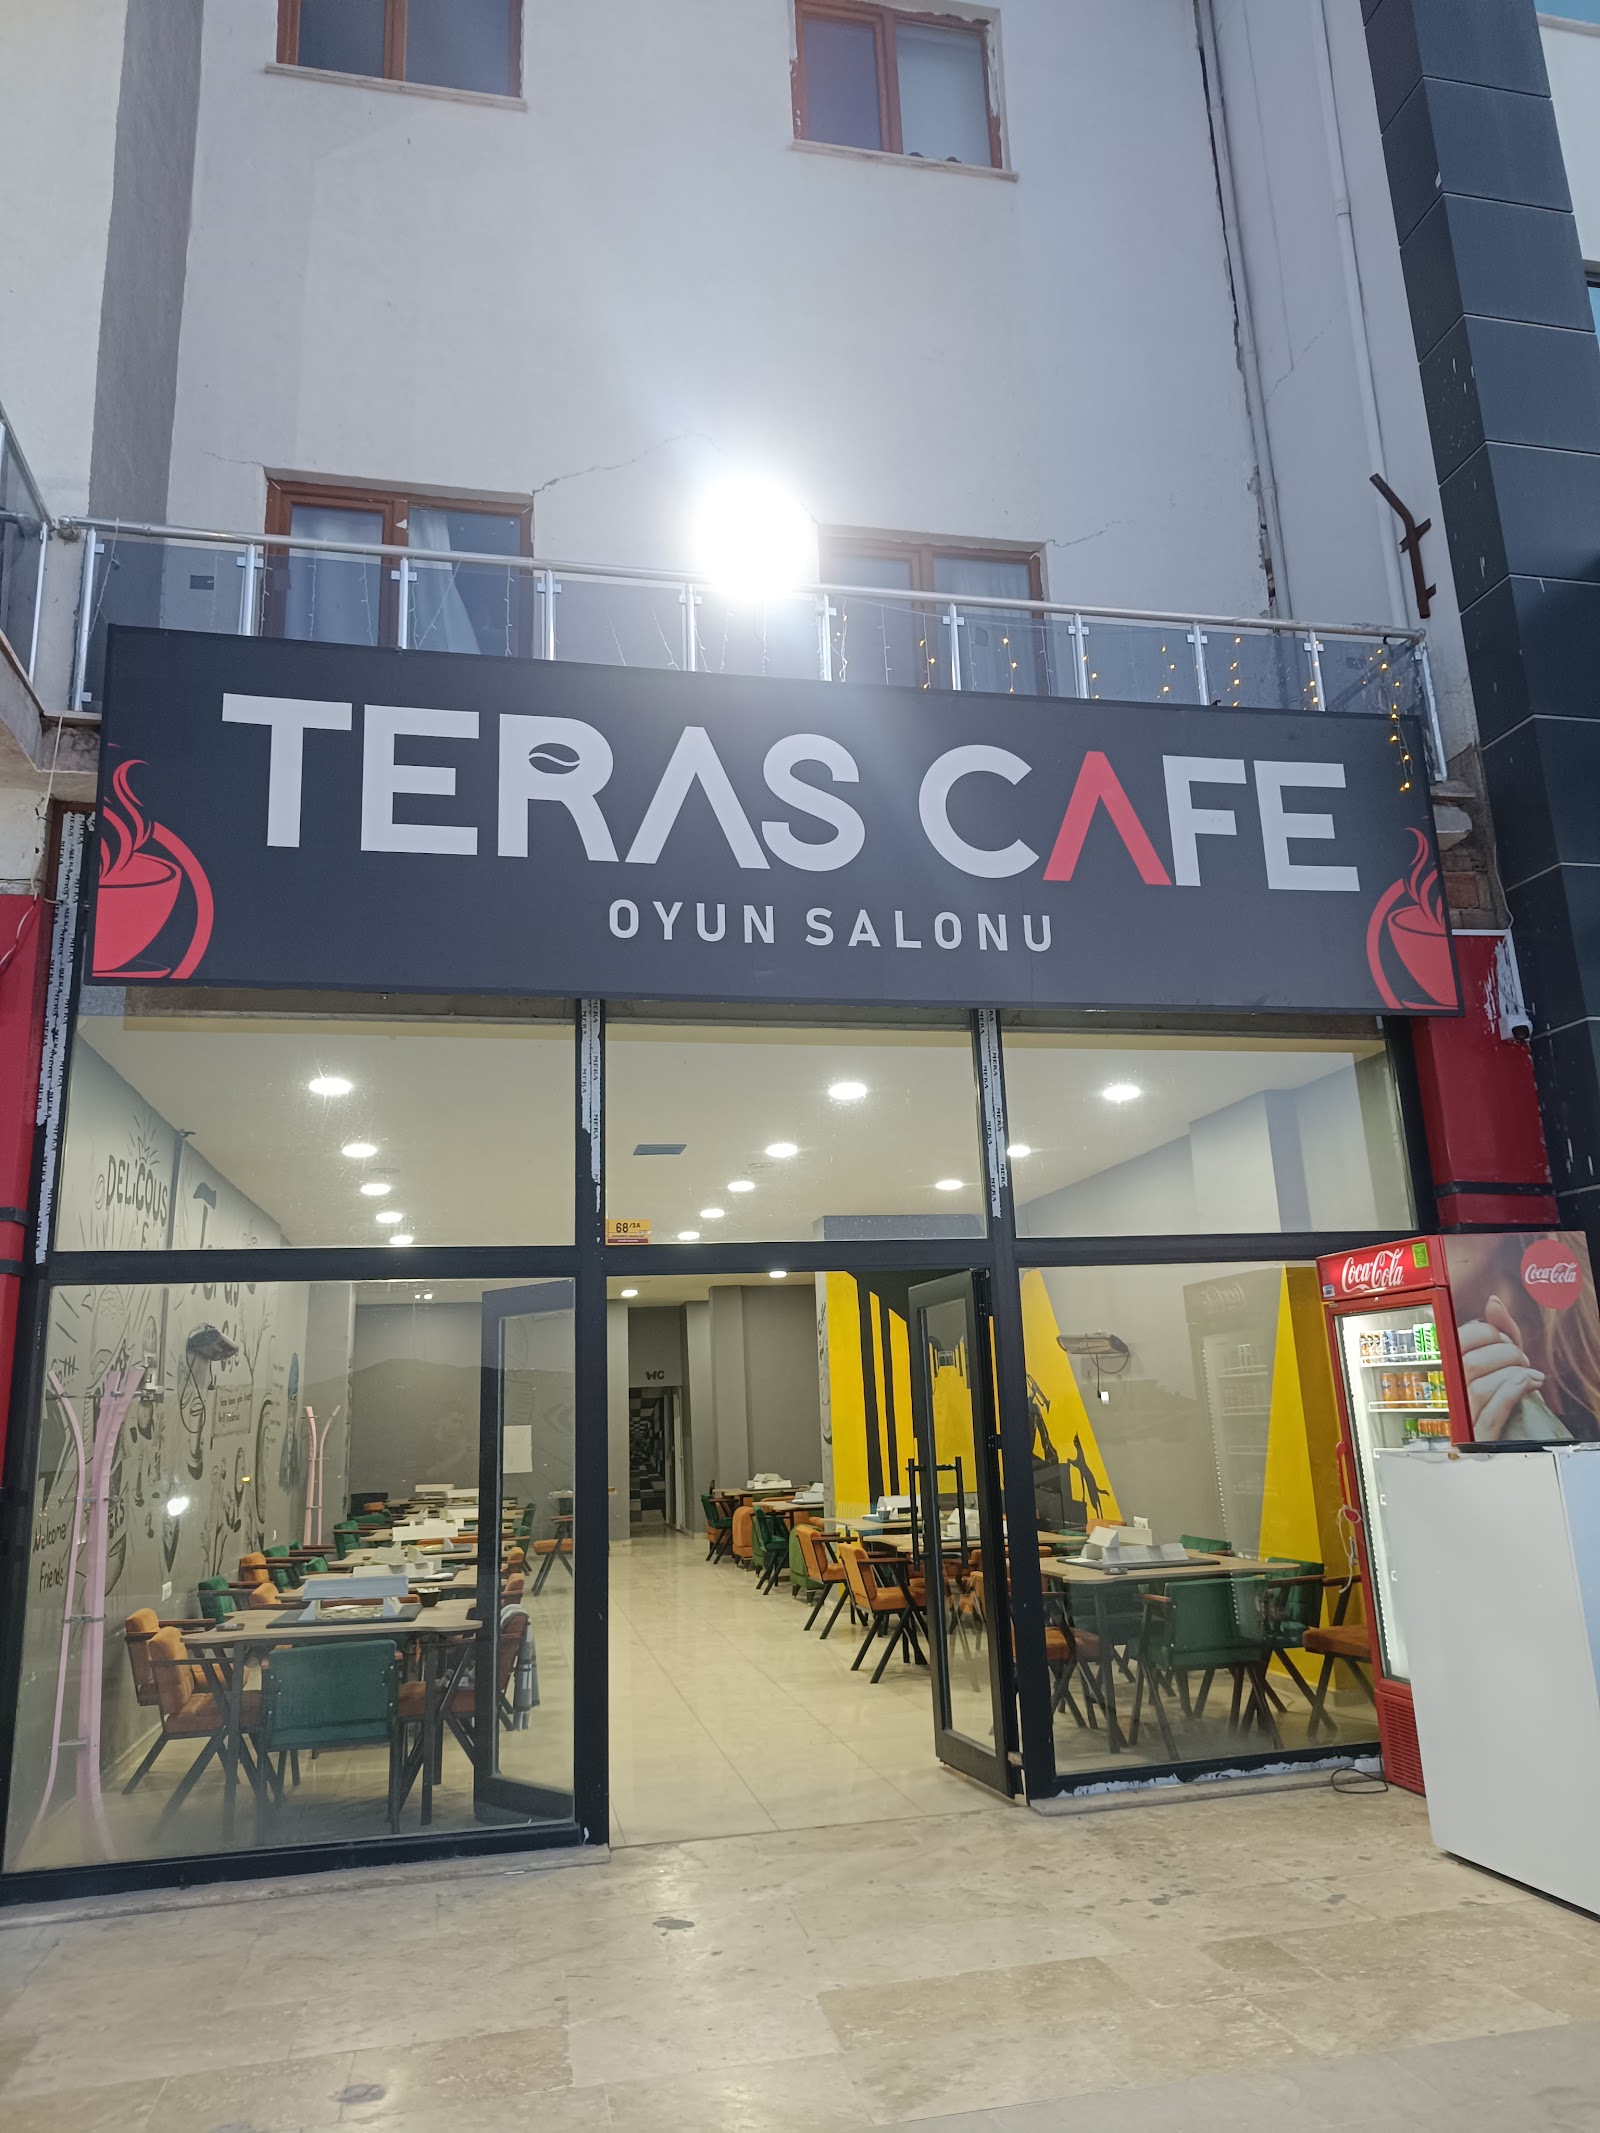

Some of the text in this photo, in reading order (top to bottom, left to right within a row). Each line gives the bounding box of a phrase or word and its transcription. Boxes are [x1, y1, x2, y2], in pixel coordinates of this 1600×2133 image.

[222, 692, 1361, 892] TERAS CAFE
[608, 898, 1052, 952] OYUN SALONU
[645, 1370, 665, 1381] WC
